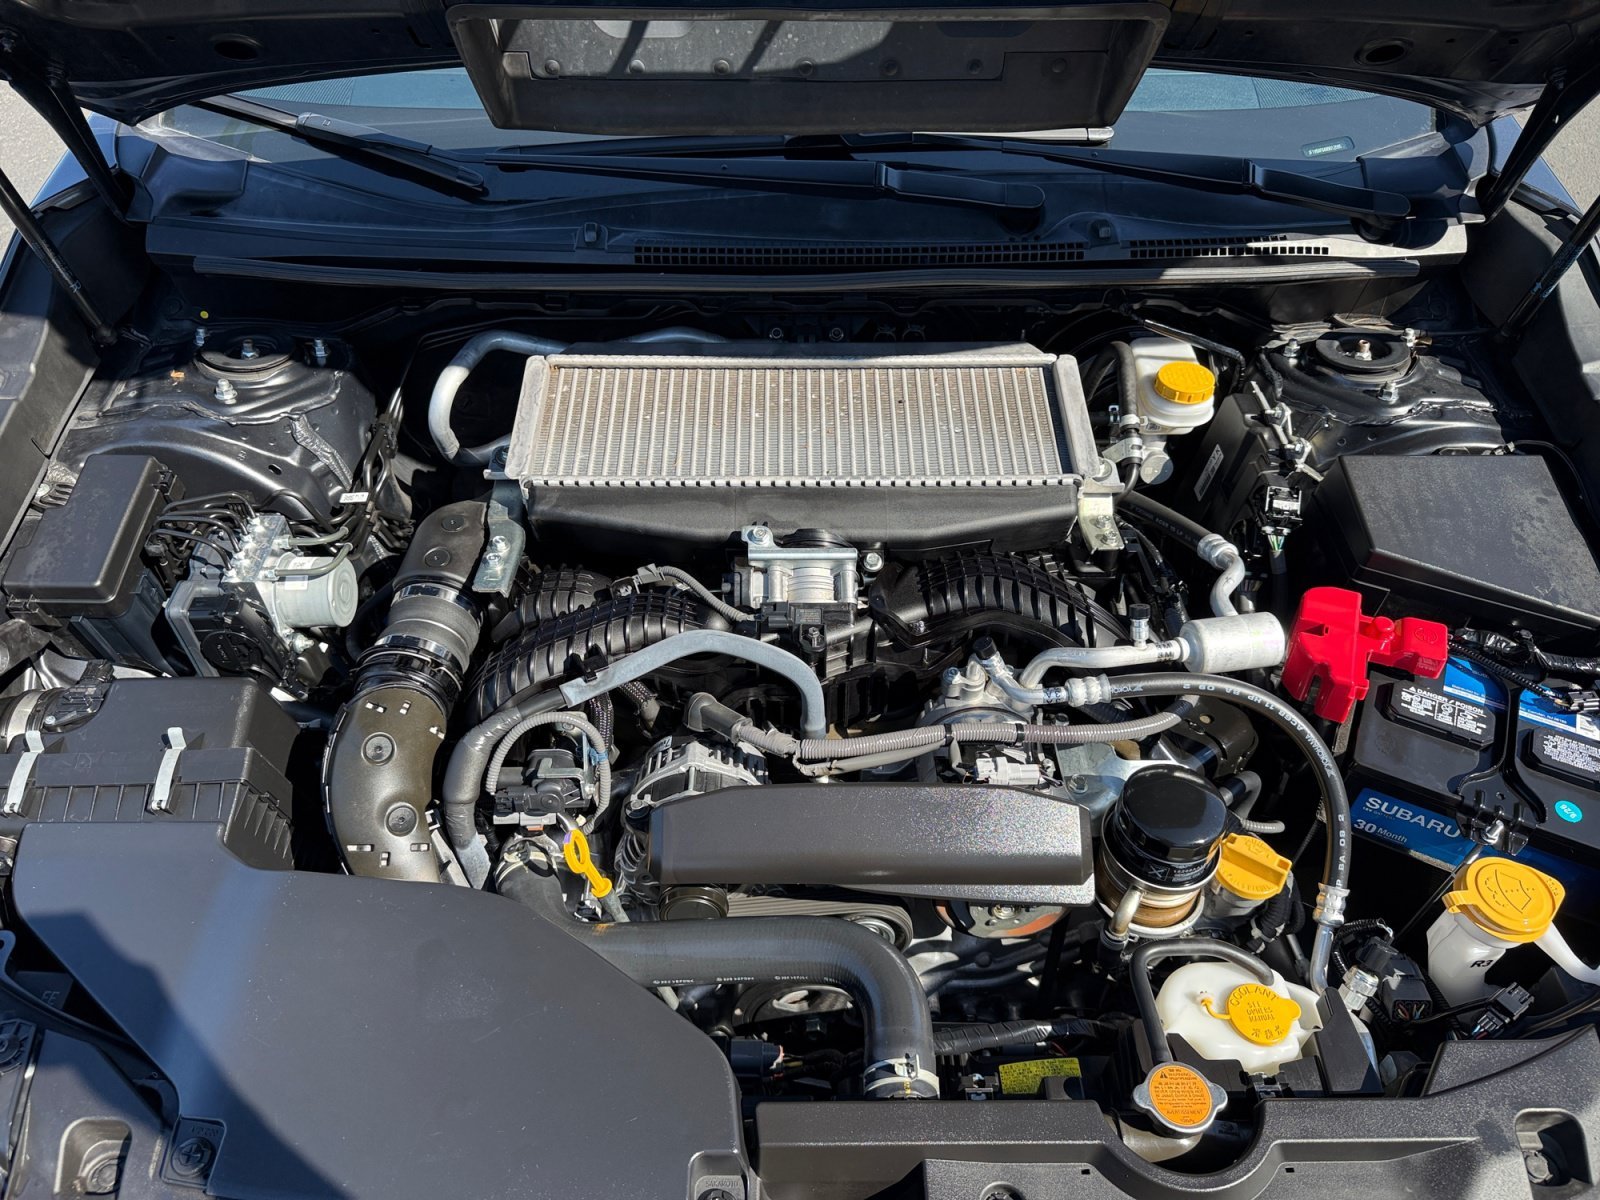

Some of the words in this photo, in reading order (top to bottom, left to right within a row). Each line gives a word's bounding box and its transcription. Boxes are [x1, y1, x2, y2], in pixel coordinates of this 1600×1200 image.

[1417, 688, 1448, 703] DANGER
[1455, 701, 1484, 714] POISON
[1304, 733, 1330, 768] YOKOHAMA
[1338, 813, 1345, 822] 2
[1365, 797, 1461, 838] SUBARU
[1353, 819, 1377, 833] 30
[1377, 827, 1408, 843] Month
[1338, 855, 1346, 871] BA
[1470, 960, 1494, 968] R3
[1230, 986, 1279, 1006] COOLANT
